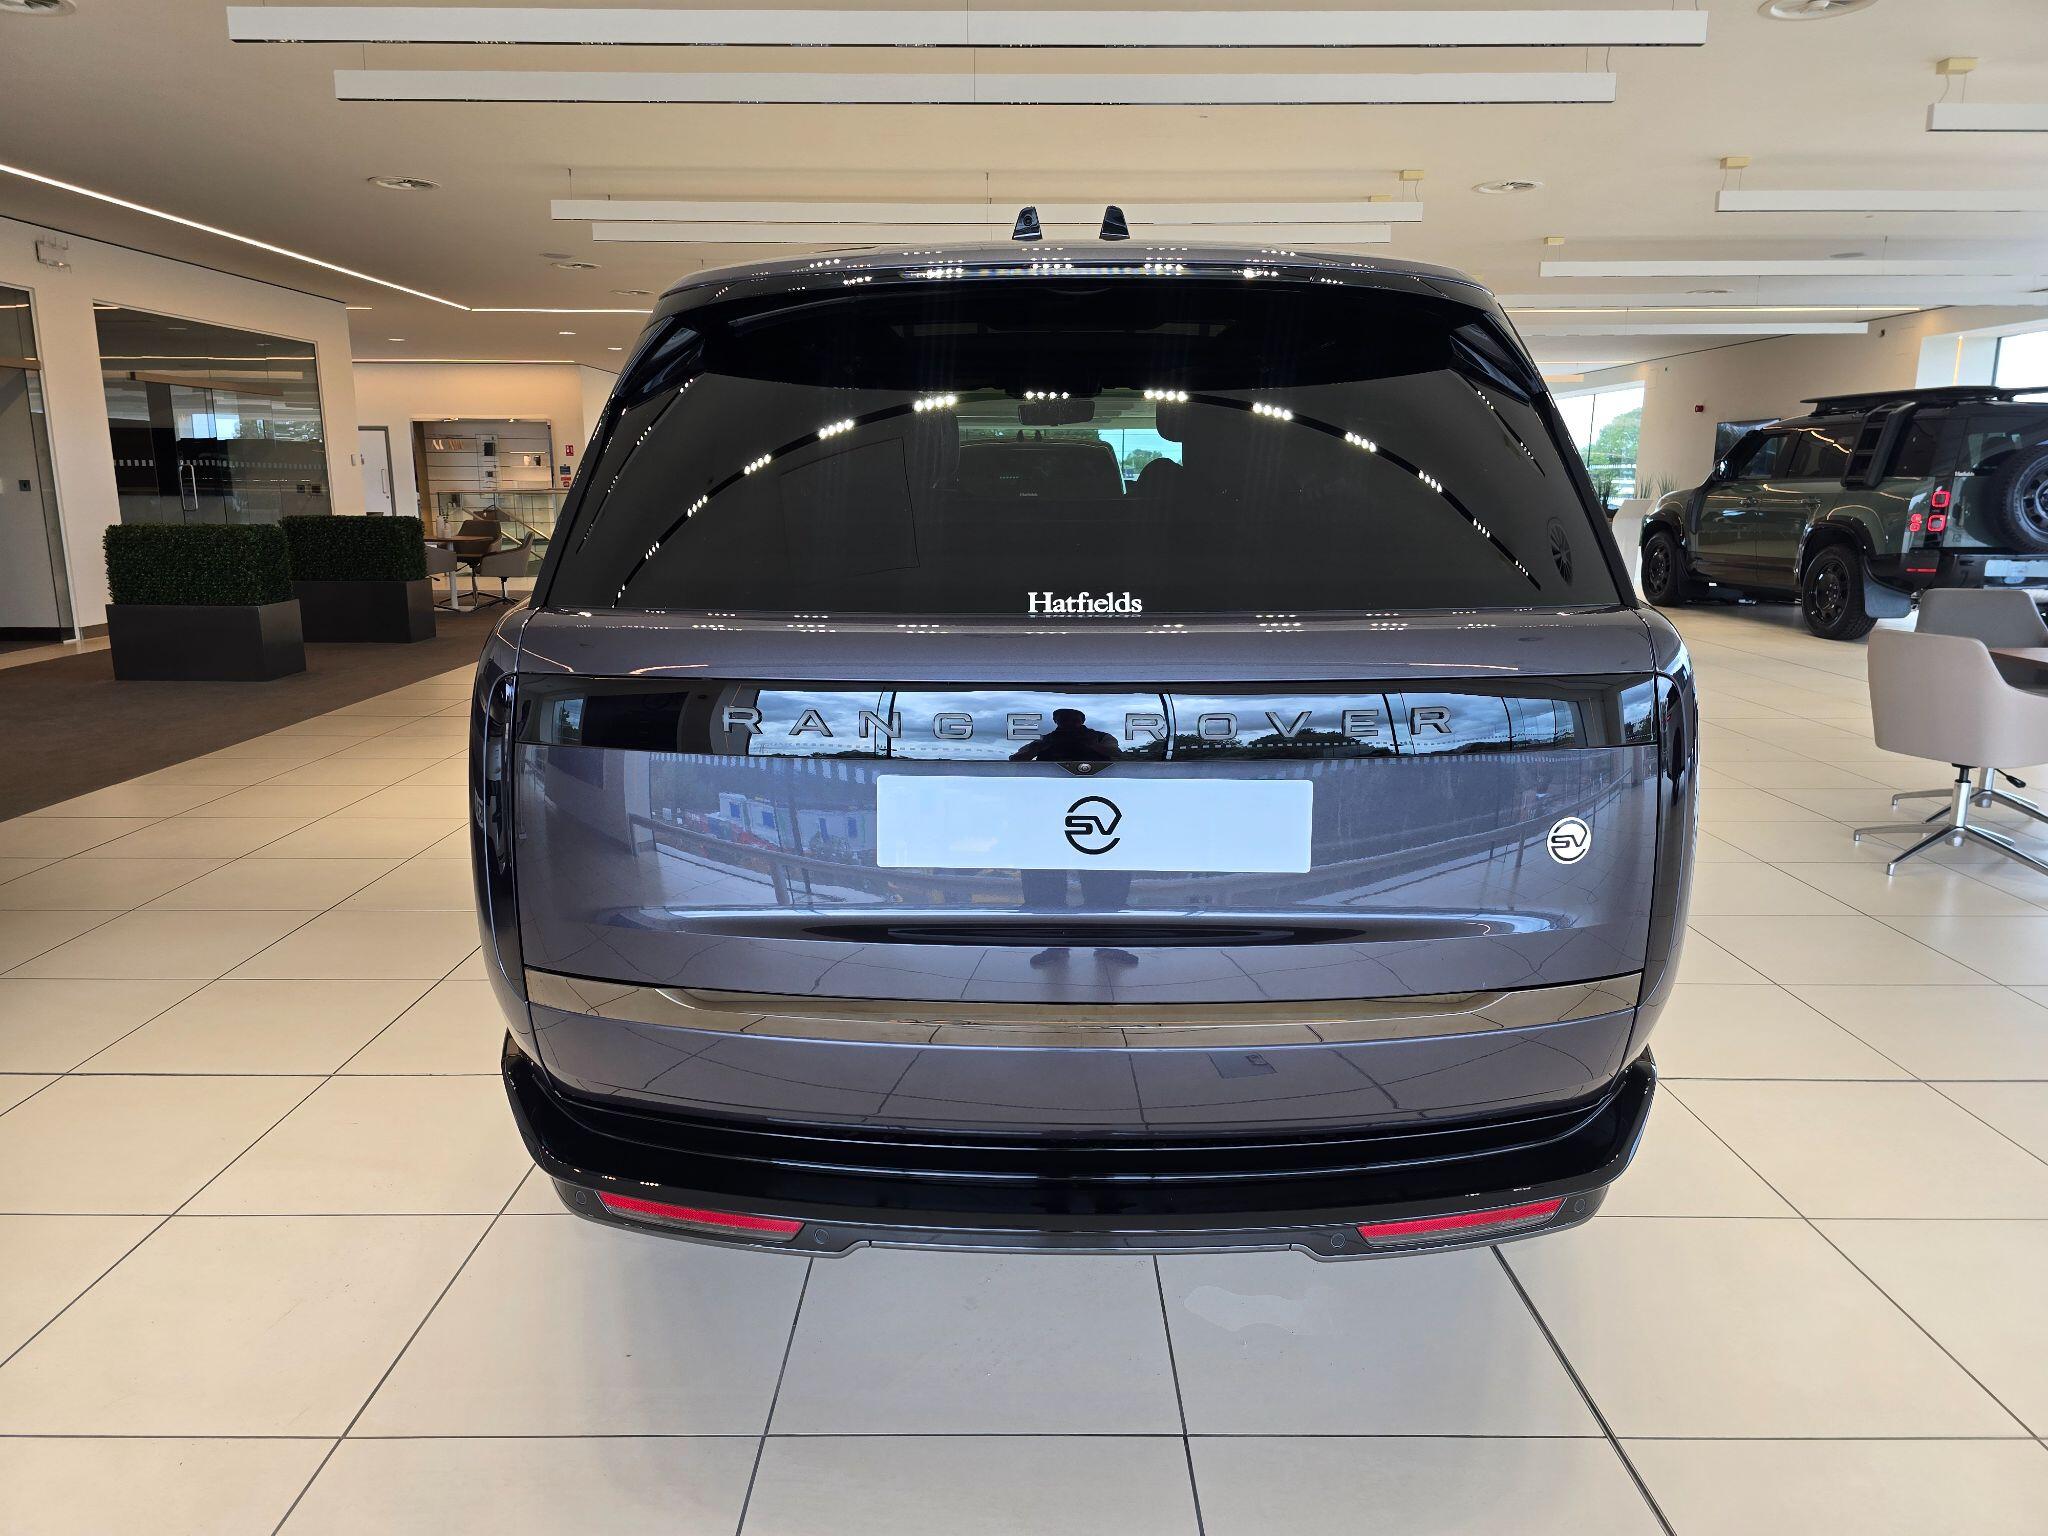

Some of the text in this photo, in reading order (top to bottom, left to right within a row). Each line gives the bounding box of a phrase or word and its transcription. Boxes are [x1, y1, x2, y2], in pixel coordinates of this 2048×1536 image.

[1027, 591, 1143, 613] Hatfields
[722, 705, 1452, 741] RANGE ROVER
[1064, 795, 1122, 855] SV
[1550, 819, 1588, 862] SV
